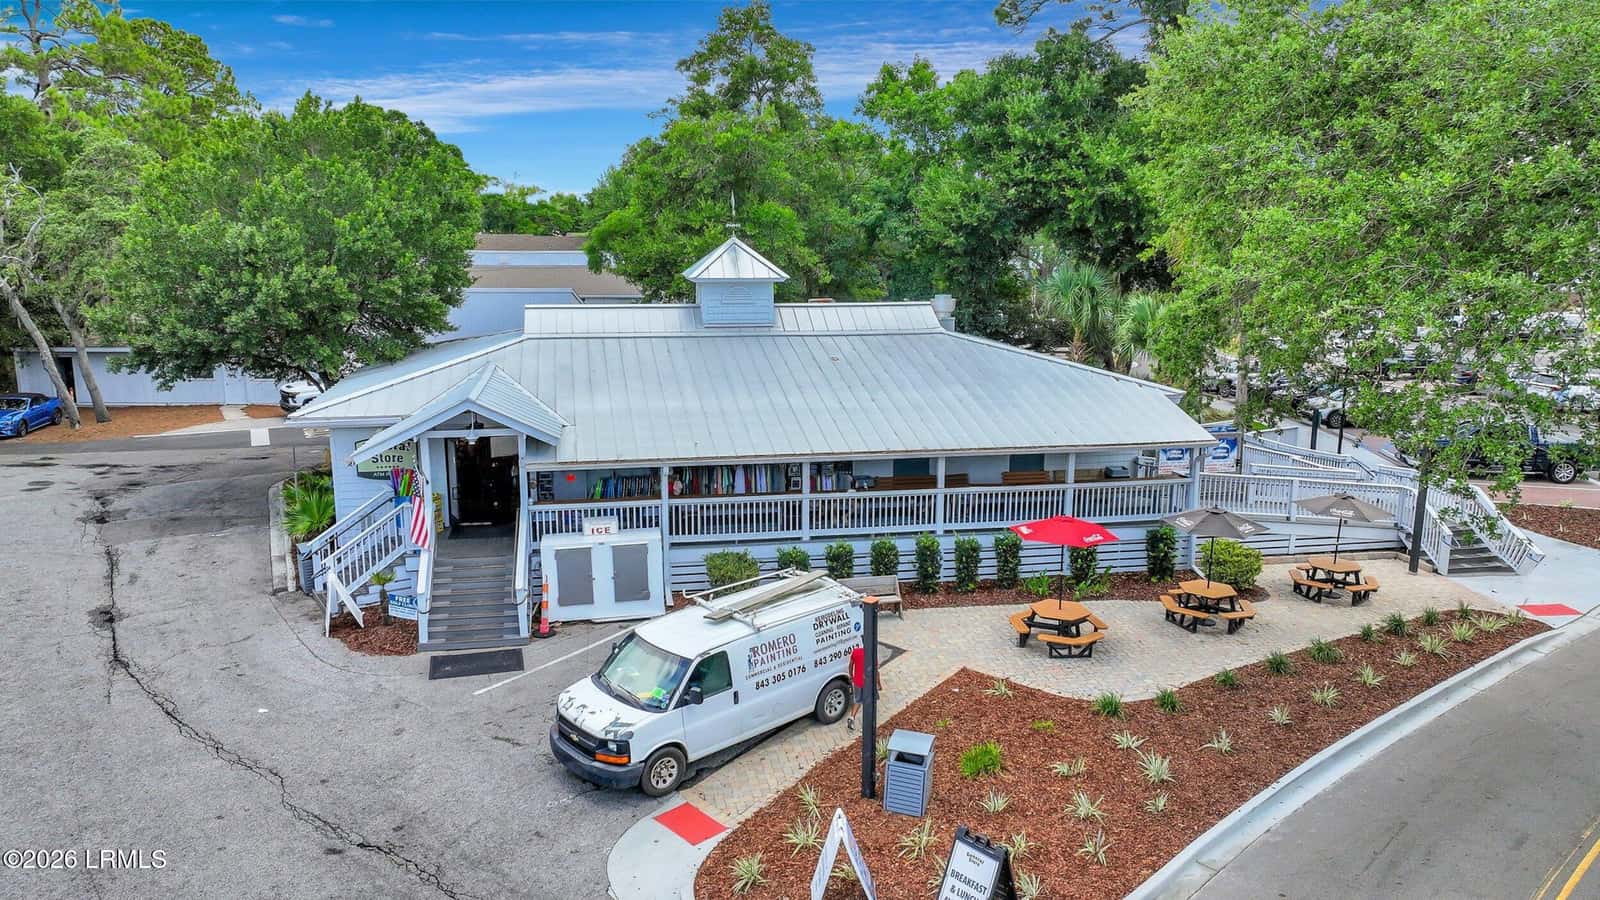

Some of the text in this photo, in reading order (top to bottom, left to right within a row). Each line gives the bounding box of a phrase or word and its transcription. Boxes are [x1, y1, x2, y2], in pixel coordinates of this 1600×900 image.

[371, 453, 404, 464] Store
[591, 527, 611, 535] ICE
[813, 612, 850, 630] DRYWALL
[815, 627, 852, 645] PAINTING
[752, 633, 796, 658] ROMERO
[753, 645, 798, 668] PAINTING
[814, 656, 828, 668] 843
[829, 650, 842, 662] 290
[755, 664, 807, 690] 843 305 0176
[950, 868, 988, 896] BREAKFAST
[950, 884, 979, 900] & LUNC
